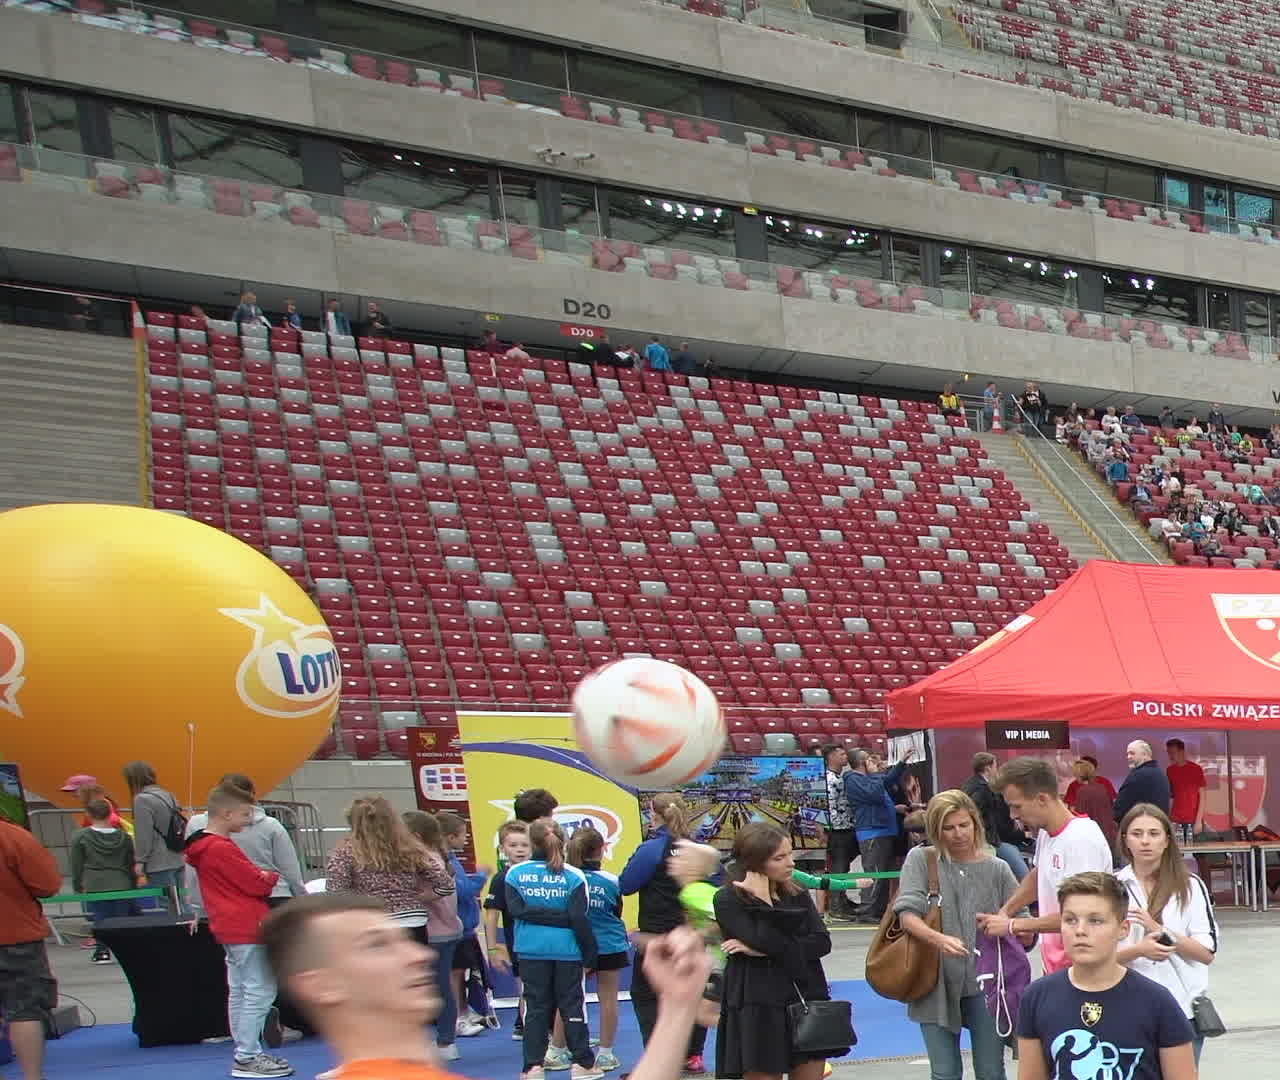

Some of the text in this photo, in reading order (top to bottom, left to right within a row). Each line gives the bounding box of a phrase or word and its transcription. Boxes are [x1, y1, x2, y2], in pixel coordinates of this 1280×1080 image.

[563, 298, 612, 320] D20
[571, 327, 594, 337] D20
[1132, 701, 1203, 717] POLSKI
[1005, 730, 1019, 739] VIP
[1025, 730, 1050, 739] MEDIA
[518, 873, 567, 885] UKS ALFA
